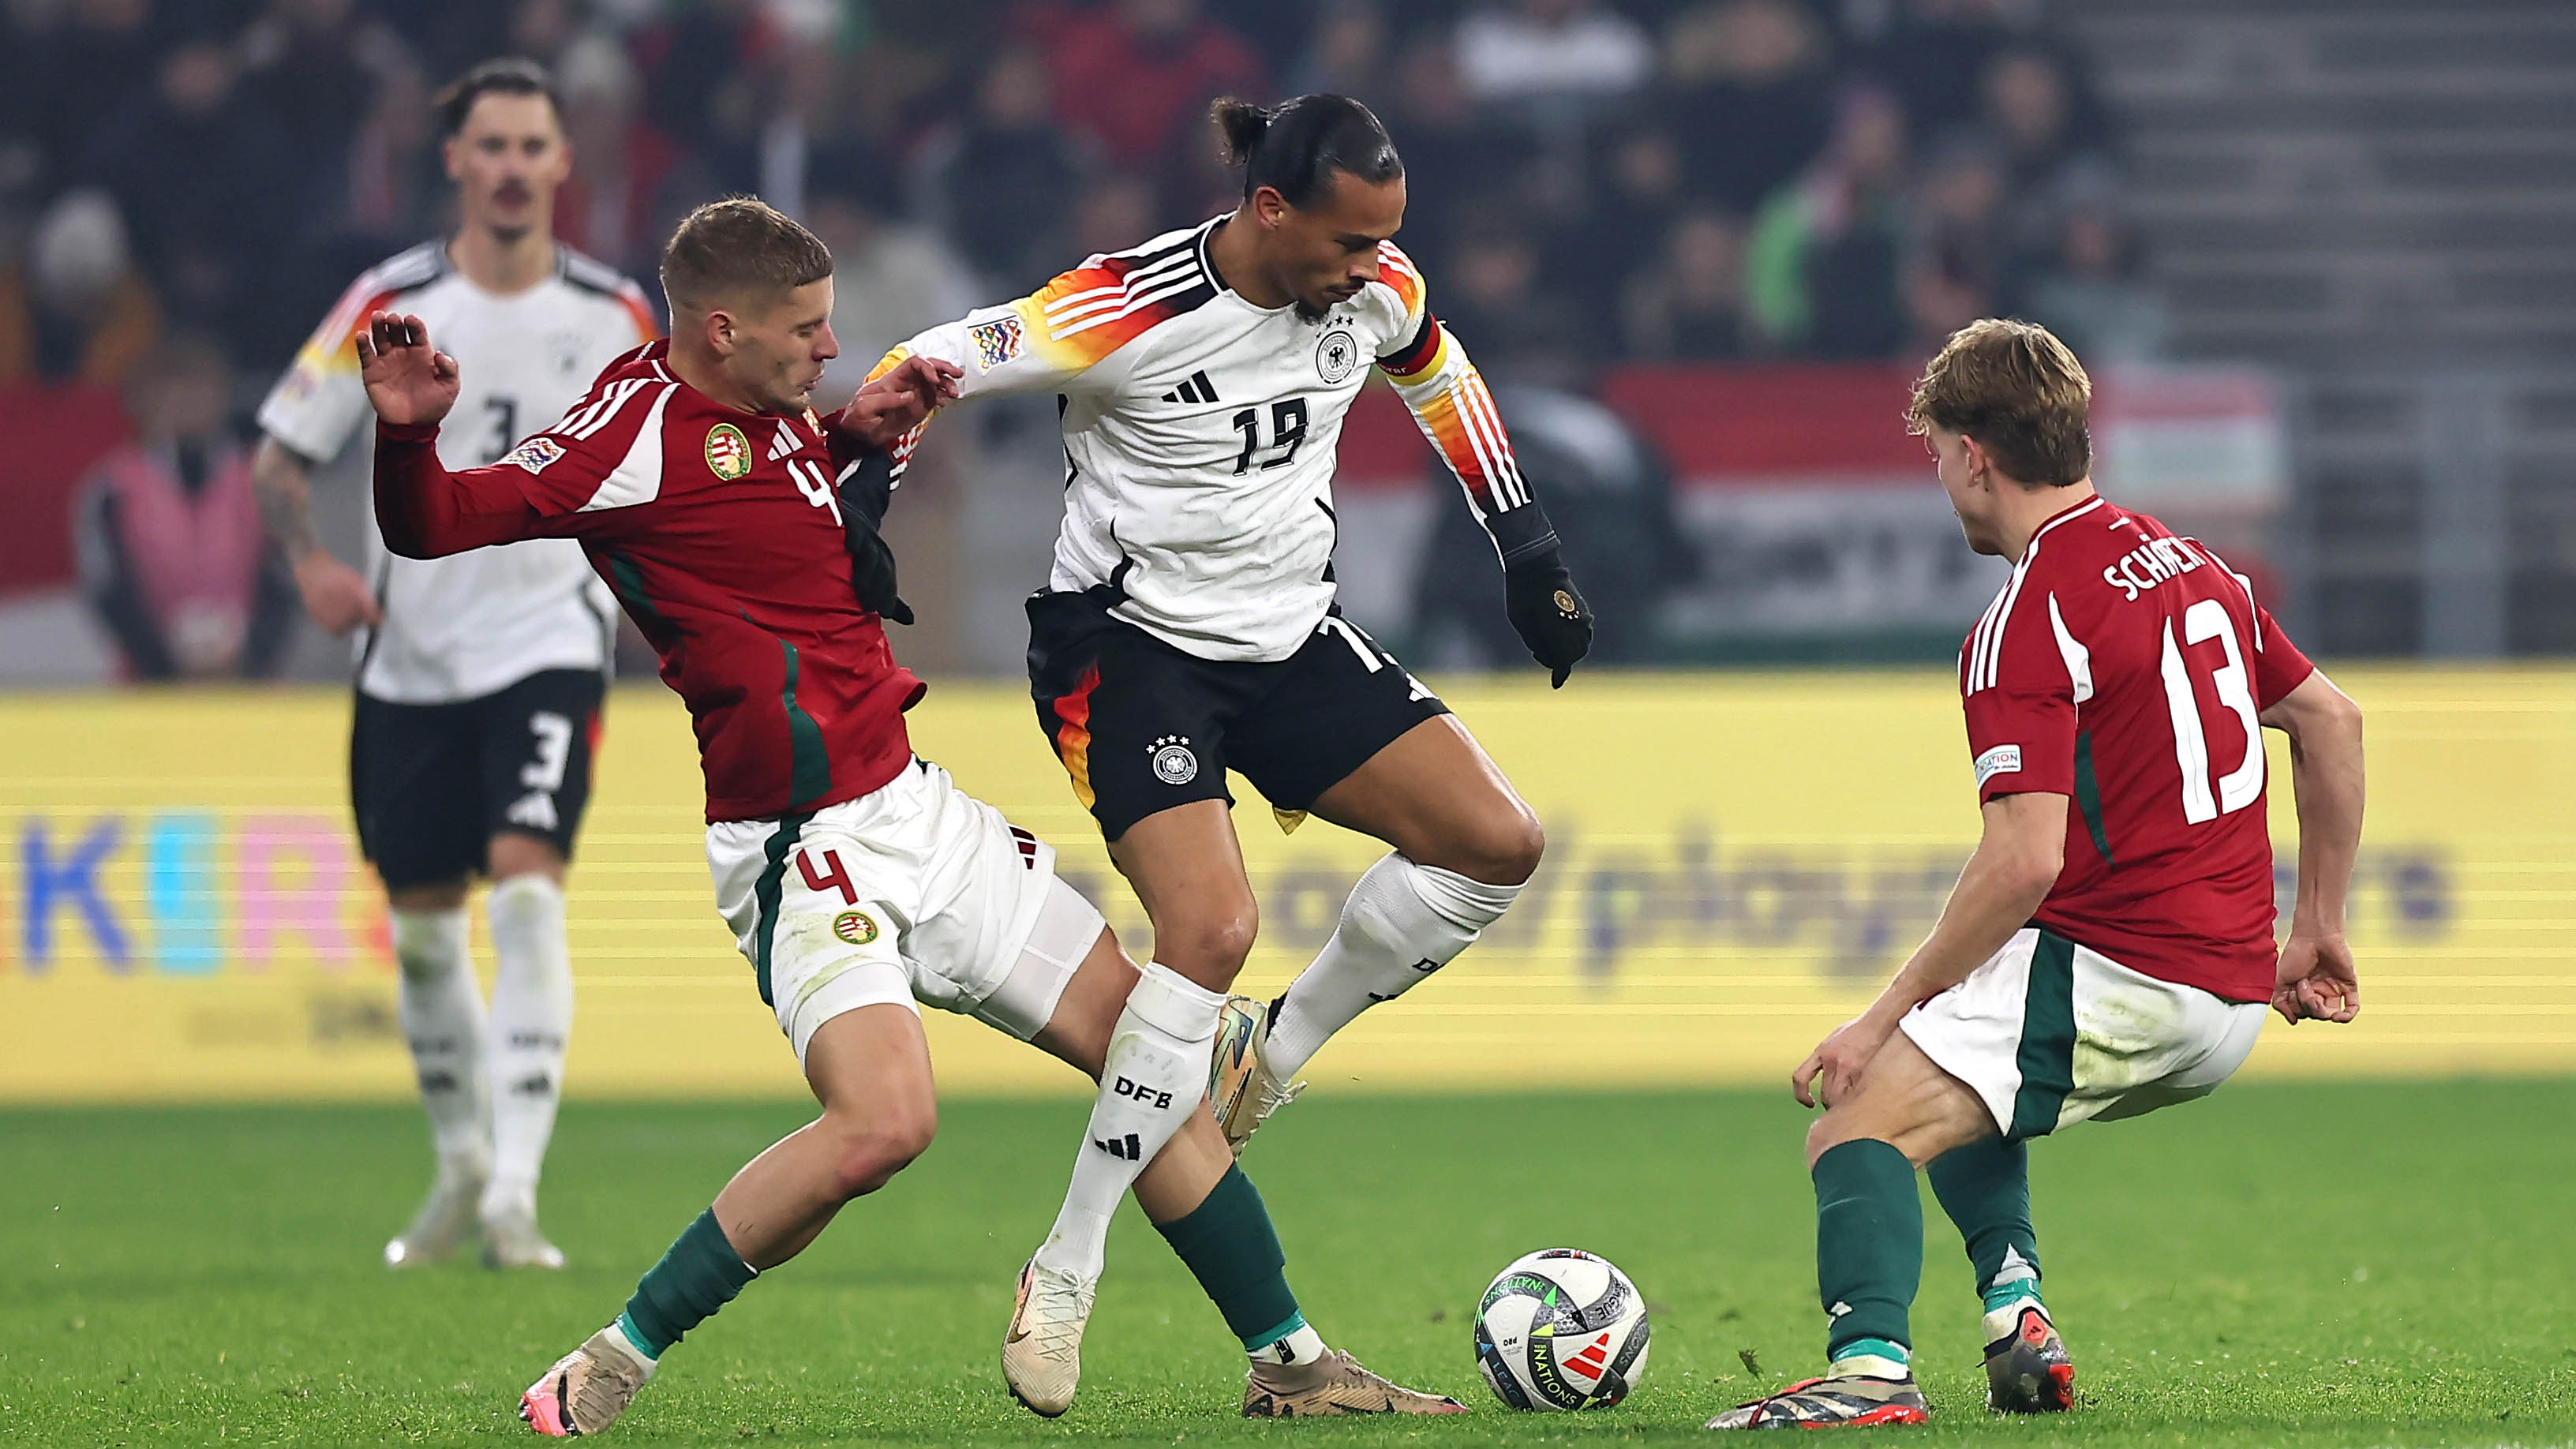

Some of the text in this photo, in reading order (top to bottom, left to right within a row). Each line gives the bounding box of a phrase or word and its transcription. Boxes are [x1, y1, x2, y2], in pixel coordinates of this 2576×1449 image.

[483, 395, 518, 464] 3
[1232, 397, 1310, 477] 19
[786, 459, 844, 528] 4
[2102, 533, 2207, 602] SCHÄER
[2161, 597, 2265, 826] 13
[520, 710, 574, 792] 3
[0, 811, 392, 975] KER
[795, 848, 859, 907] 4
[1114, 1075, 1173, 1110] DFB
[1485, 1277, 1541, 1306] NATIONS
[1503, 1335, 1518, 1346] PRO
[1533, 1350, 1578, 1405] NATIONS
